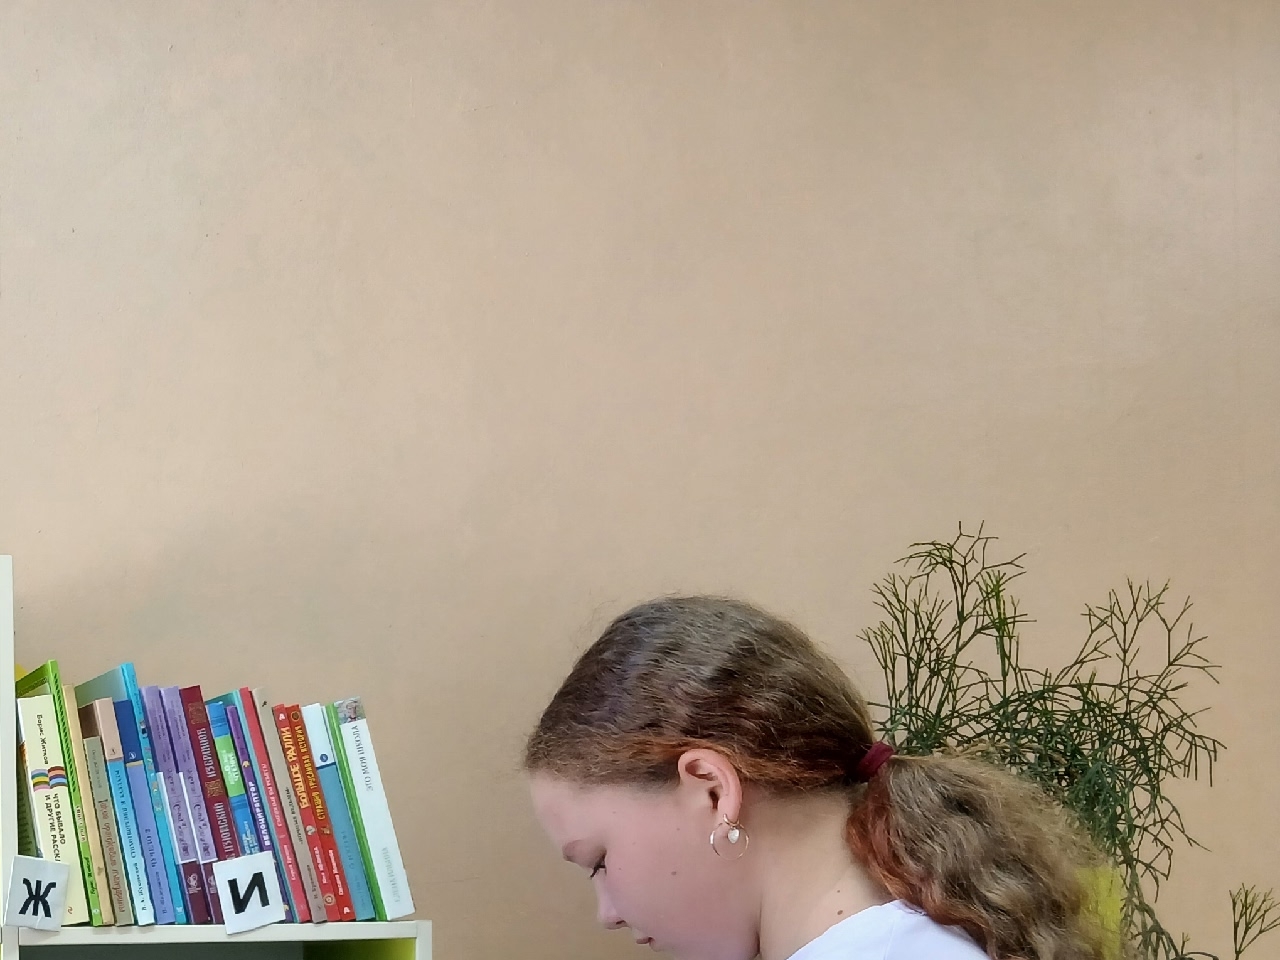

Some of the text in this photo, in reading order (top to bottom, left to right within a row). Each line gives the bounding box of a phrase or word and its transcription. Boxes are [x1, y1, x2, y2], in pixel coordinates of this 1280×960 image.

[34, 713, 46, 736] Борис
[280, 725, 298, 762] РАЛЛИ
[290, 762, 310, 809] БОЛЬШОЕ
[43, 802, 56, 832] ДРУГИЕ
[50, 792, 66, 845] ЧТО БЫВАЛО
[19, 878, 56, 917] Ж
[228, 871, 272, 914] И
